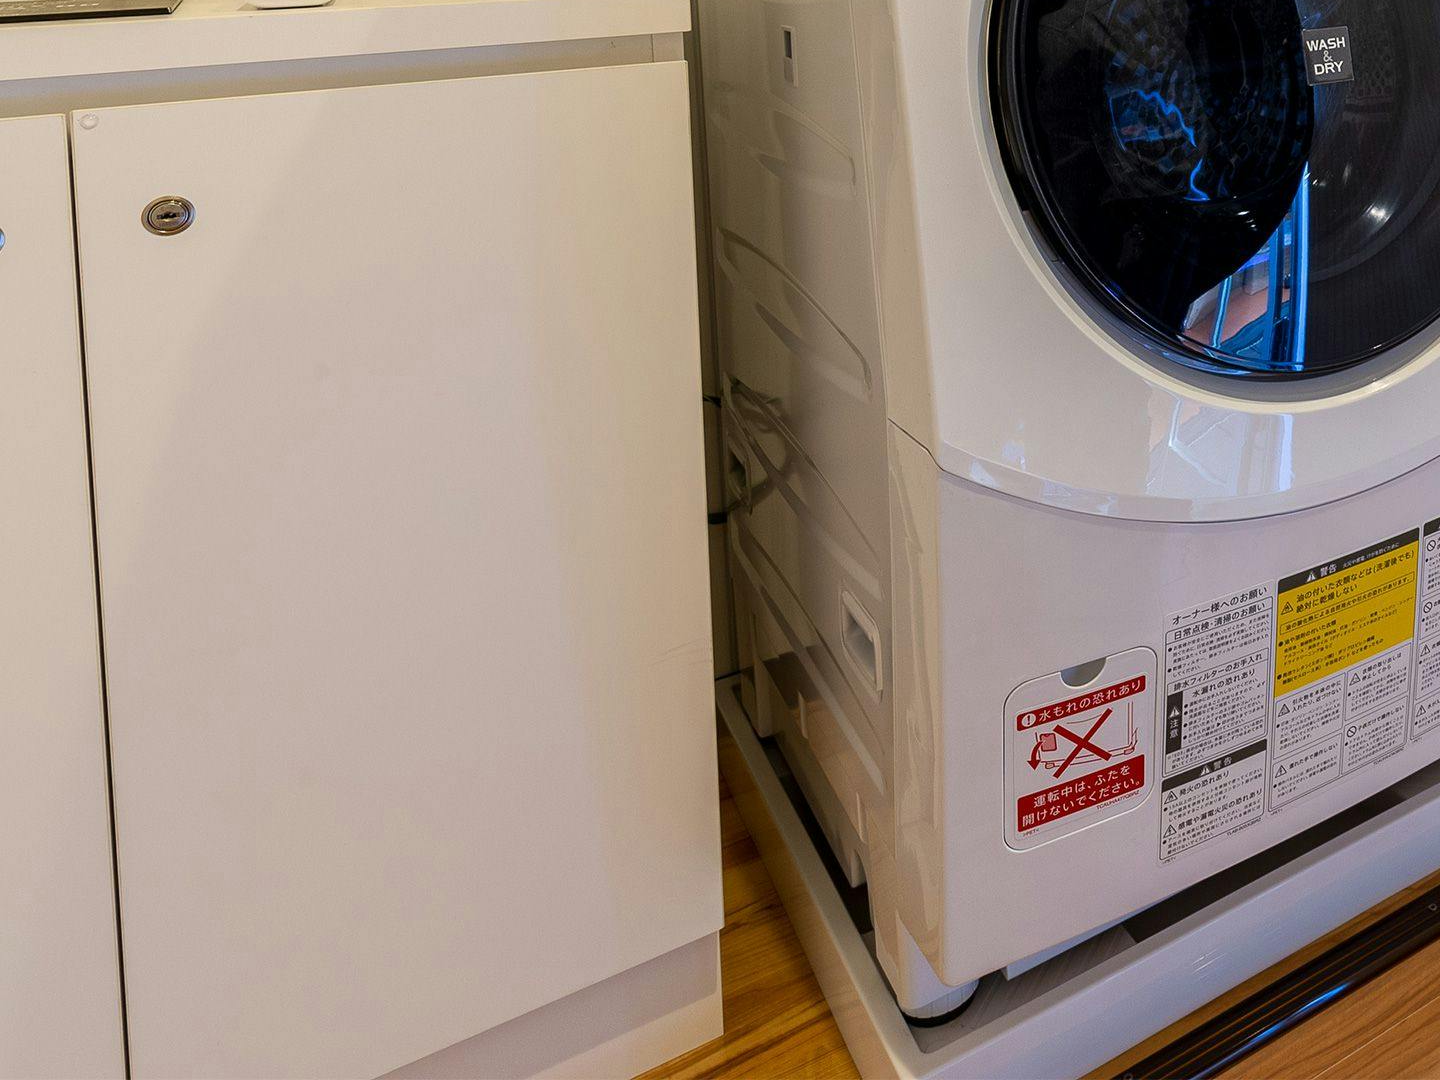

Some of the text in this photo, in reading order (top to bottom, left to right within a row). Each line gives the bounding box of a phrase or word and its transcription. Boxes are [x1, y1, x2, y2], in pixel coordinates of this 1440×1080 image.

[1306, 36, 1346, 52] WASH
[1323, 50, 1333, 62] &
[1314, 61, 1344, 75] DRY
[1320, 563, 1337, 577] 警告
[1172, 586, 1268, 626] オーナー様へのお願い
[1296, 584, 1358, 613] 絶対に乾燥しない
[1174, 603, 1266, 640] 日常点検・清掃のお願い
[1174, 653, 1263, 691] 排水フィルターのお手入れ
[1192, 669, 1255, 697] 水漏れの恐れあり
[1039, 679, 1140, 721] 水もれの恐れあり
[1022, 778, 1141, 827] 開けないでください。
[1033, 765, 1131, 809] 運転中は、ふたを
[1178, 788, 1262, 830] 感電や漏電火災の恐れあり
